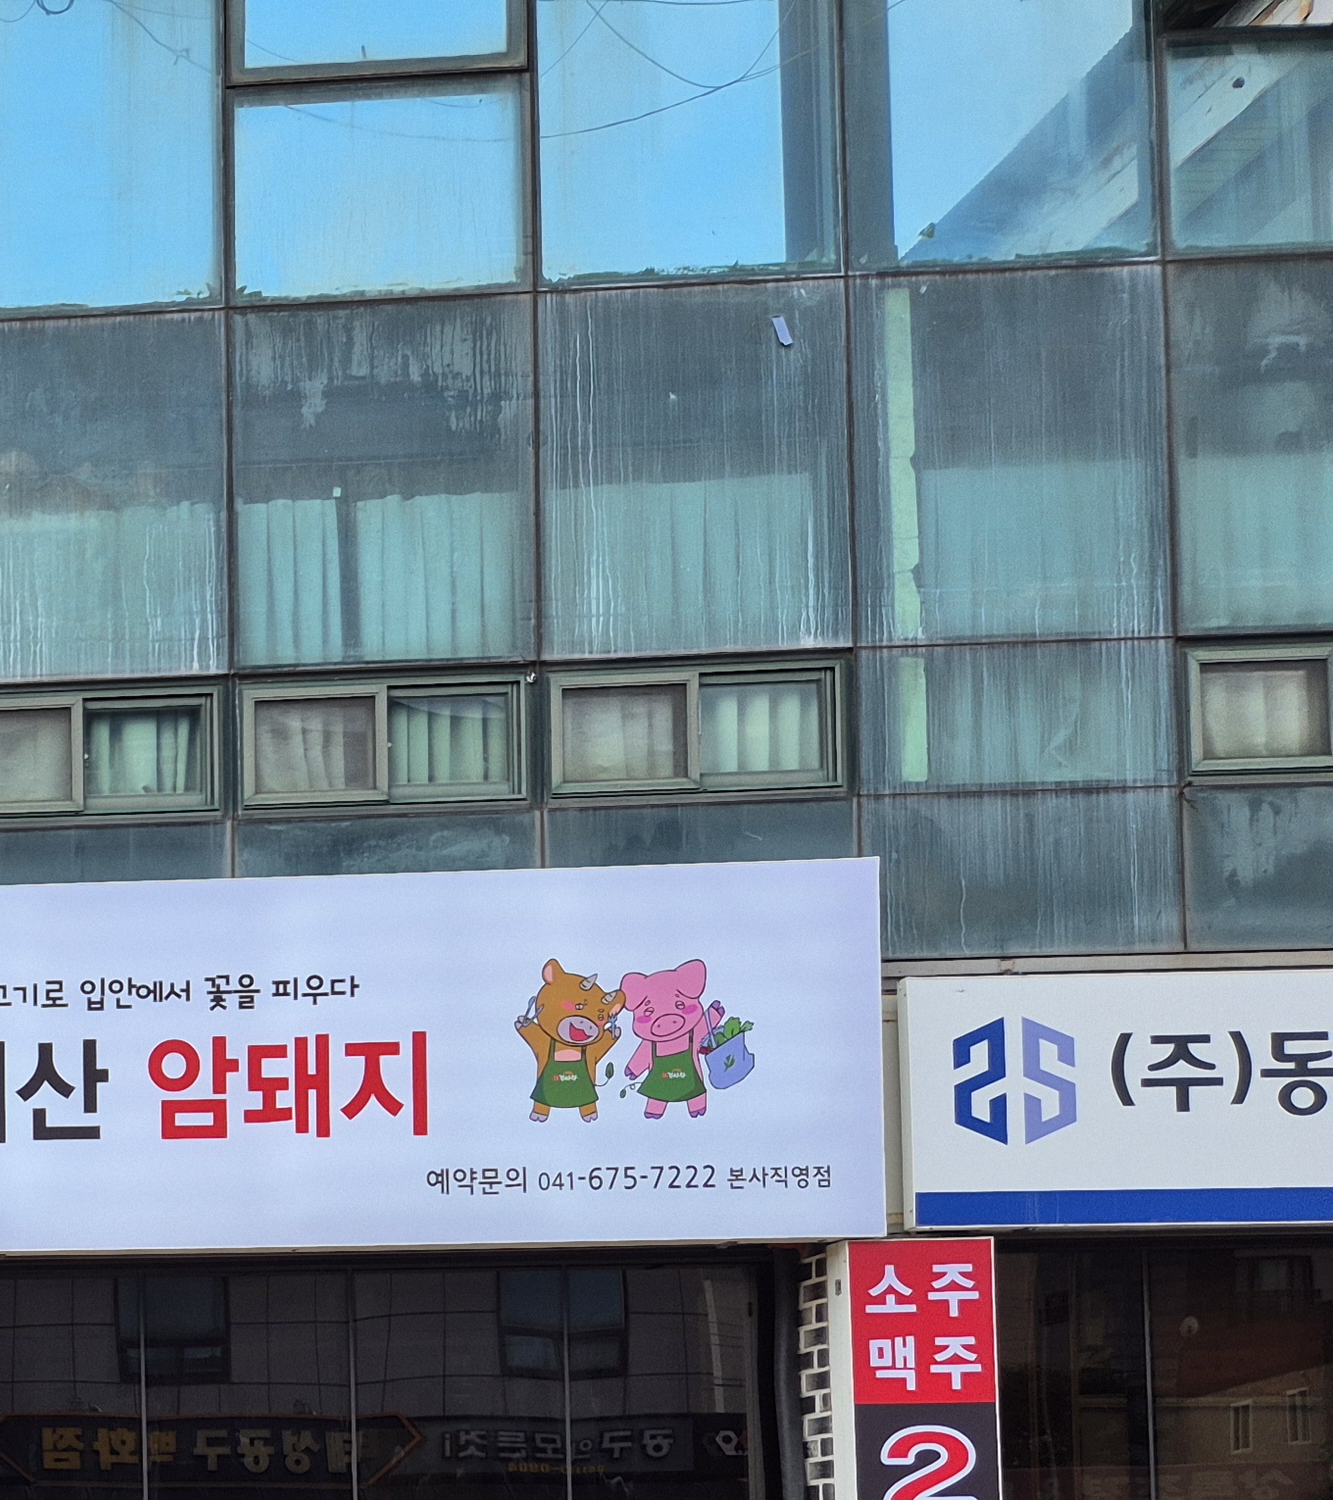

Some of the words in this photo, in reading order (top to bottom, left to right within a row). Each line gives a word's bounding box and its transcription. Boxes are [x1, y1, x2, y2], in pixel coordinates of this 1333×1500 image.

[79, 977, 191, 1012] 입안에서
[205, 973, 260, 1011] 꽃을
[271, 975, 360, 1006] 피우다
[147, 1030, 428, 1139] 암돼지
[426, 1165, 528, 1195] 예약문의
[538, 1164, 716, 1192] 041-675-7222
[727, 1165, 832, 1189] 본사직영점
[865, 1263, 979, 1317] 소주
[869, 1335, 982, 1391] 맥주
